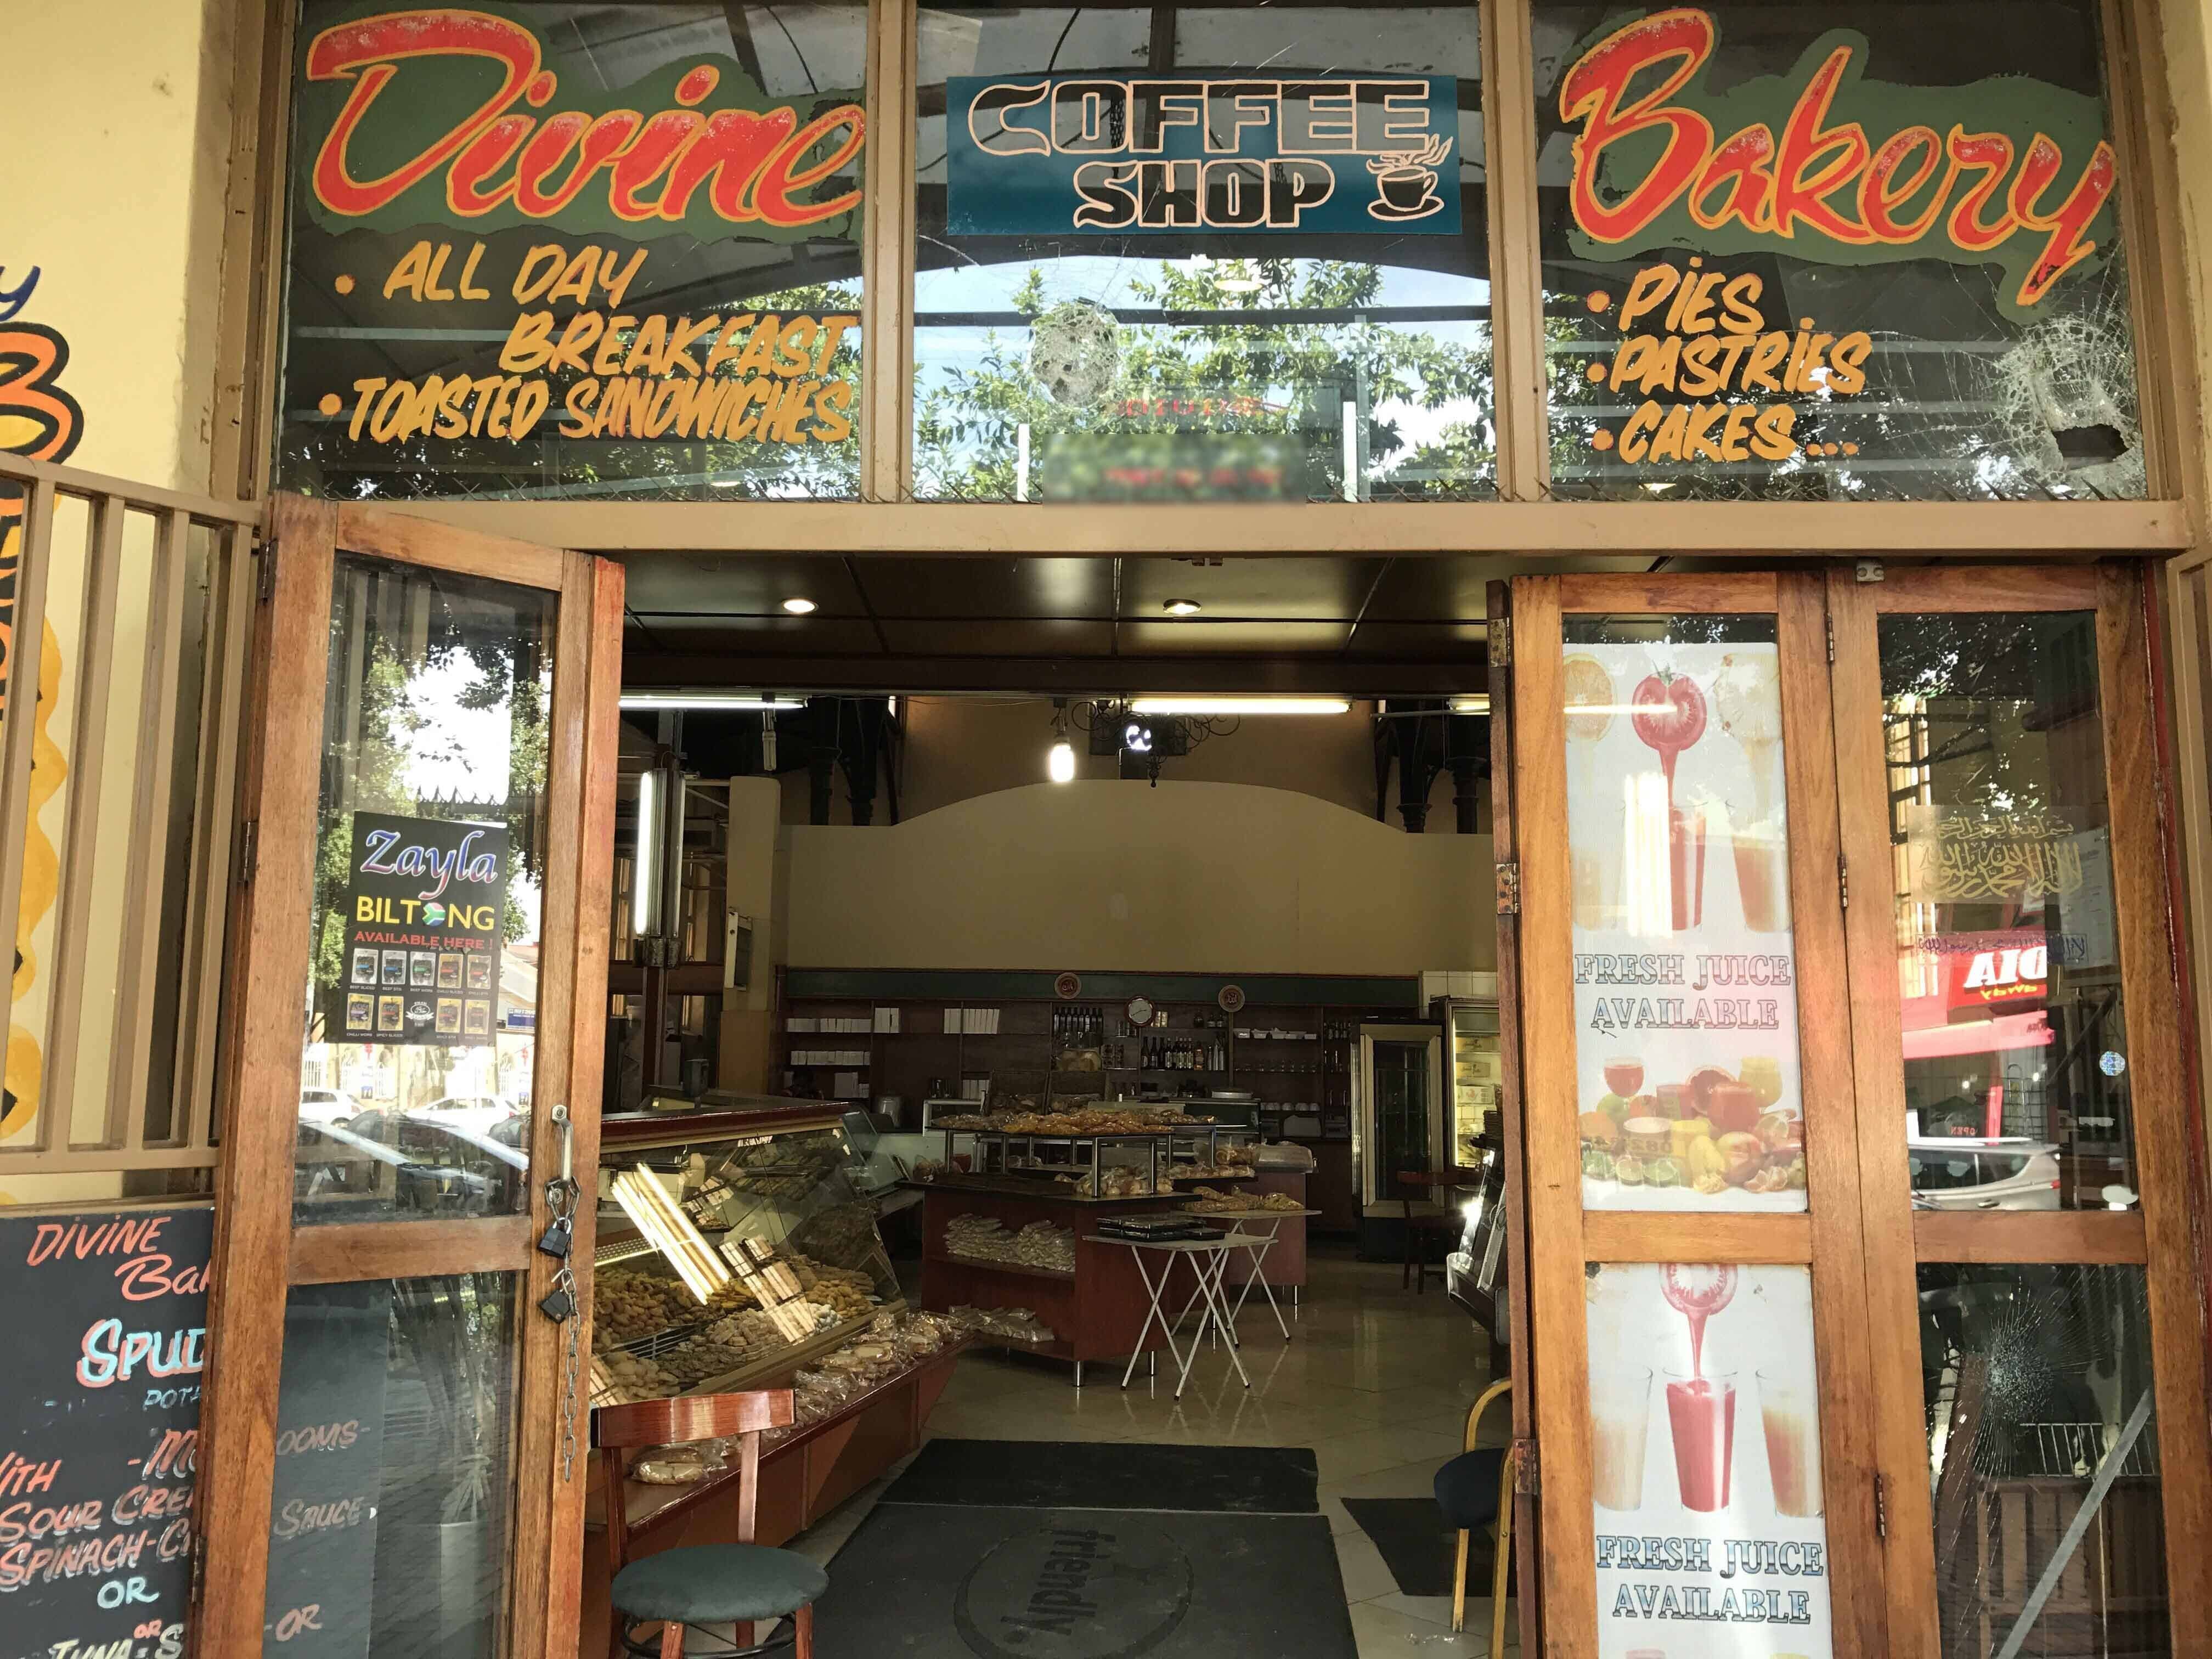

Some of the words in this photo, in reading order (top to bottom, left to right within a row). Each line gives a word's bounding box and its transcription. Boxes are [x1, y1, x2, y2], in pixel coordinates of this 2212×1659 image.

[306, 8, 866, 227] Divine
[968, 79, 1430, 156] COFFEE
[1560, 7, 2118, 306] Bakery
[1074, 159, 1334, 228] SHOP
[383, 240, 490, 302] ALL
[512, 243, 648, 309] DAY
[498, 312, 860, 377] BREAKFAST
[348, 373, 549, 444] TOASTED
[558, 376, 855, 444] SANDWICHES
[360, 830, 498, 900] Zayla
[354, 931, 439, 947] AVAILABLE
[443, 936, 484, 949] HERE
[1575, 953, 1685, 985] FRESH
[1692, 953, 1792, 991] JUICE
[1590, 997, 1780, 1030] AVAILABLE
[1596, 1535, 1712, 1572] FRESH
[1719, 1539, 1824, 1579] JUICE
[97, 1576, 160, 1609] OR
[1612, 1583, 1811, 1625] AVAILABLE
